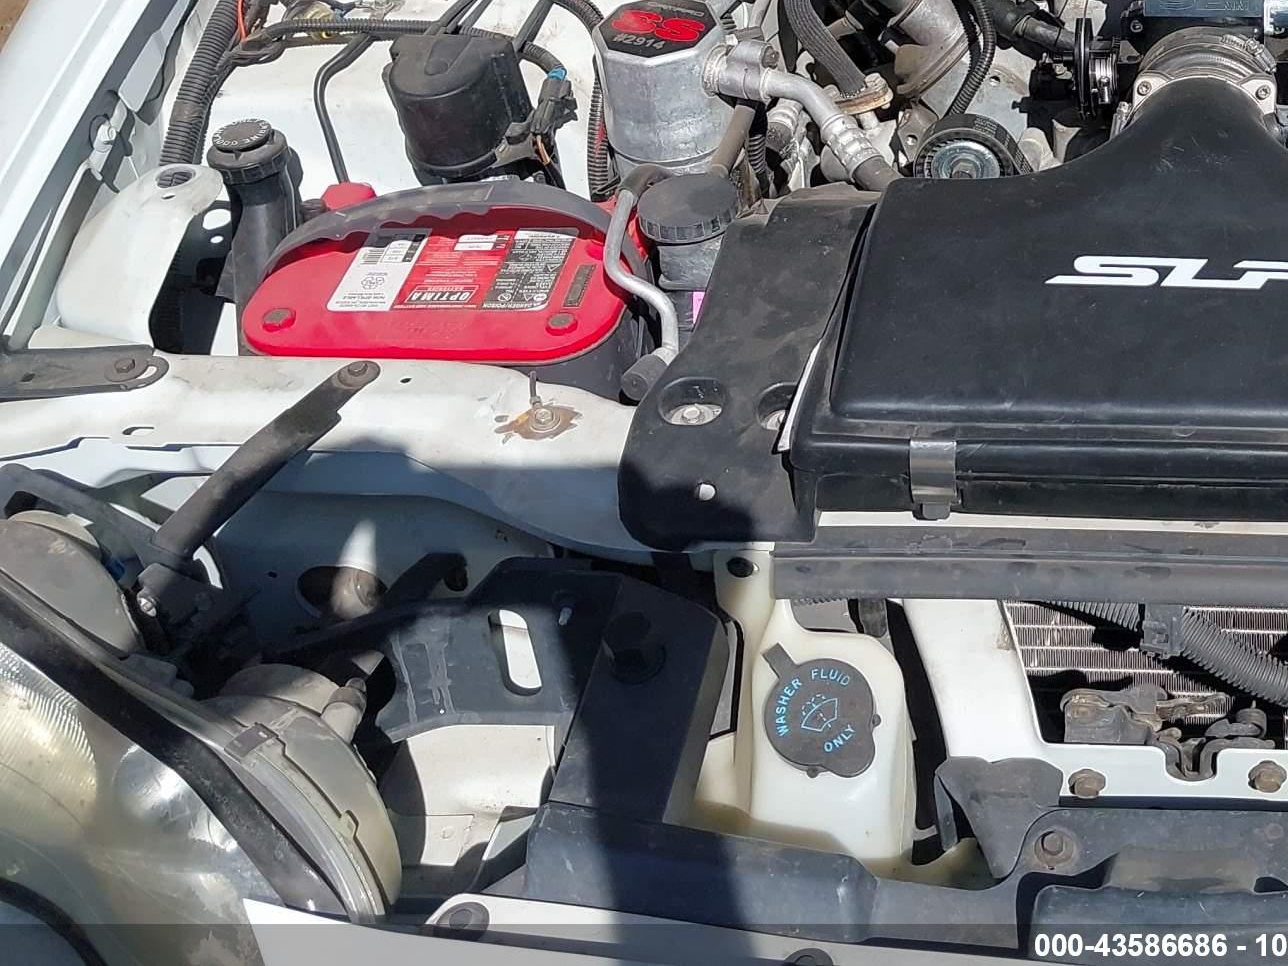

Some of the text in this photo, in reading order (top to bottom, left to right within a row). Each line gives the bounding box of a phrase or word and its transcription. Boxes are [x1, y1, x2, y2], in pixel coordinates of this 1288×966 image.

[611, 9, 706, 42] SS
[612, 33, 667, 50] #2914
[411, 291, 471, 301] OPTIMA
[775, 668, 852, 737] WASHER FLUID
[823, 723, 856, 753] ONLY
